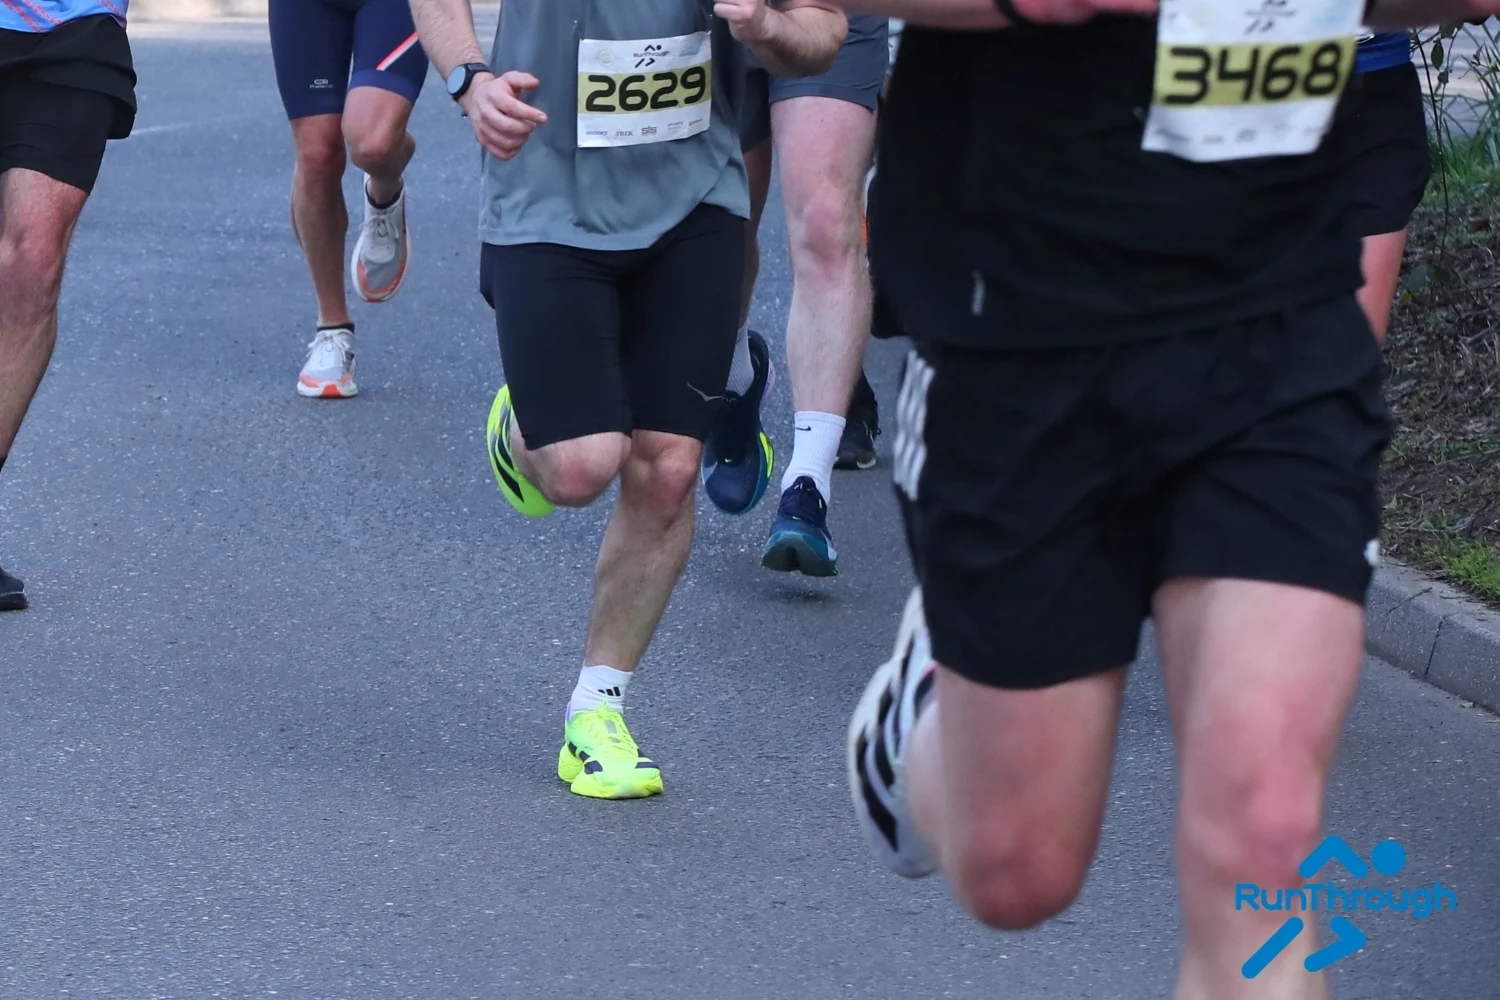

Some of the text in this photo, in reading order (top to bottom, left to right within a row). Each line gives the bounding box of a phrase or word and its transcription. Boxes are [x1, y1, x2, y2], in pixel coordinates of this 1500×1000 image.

[632, 50, 669, 58] RunThrough
[1162, 42, 1342, 106] 3468
[585, 66, 706, 112] 2629
